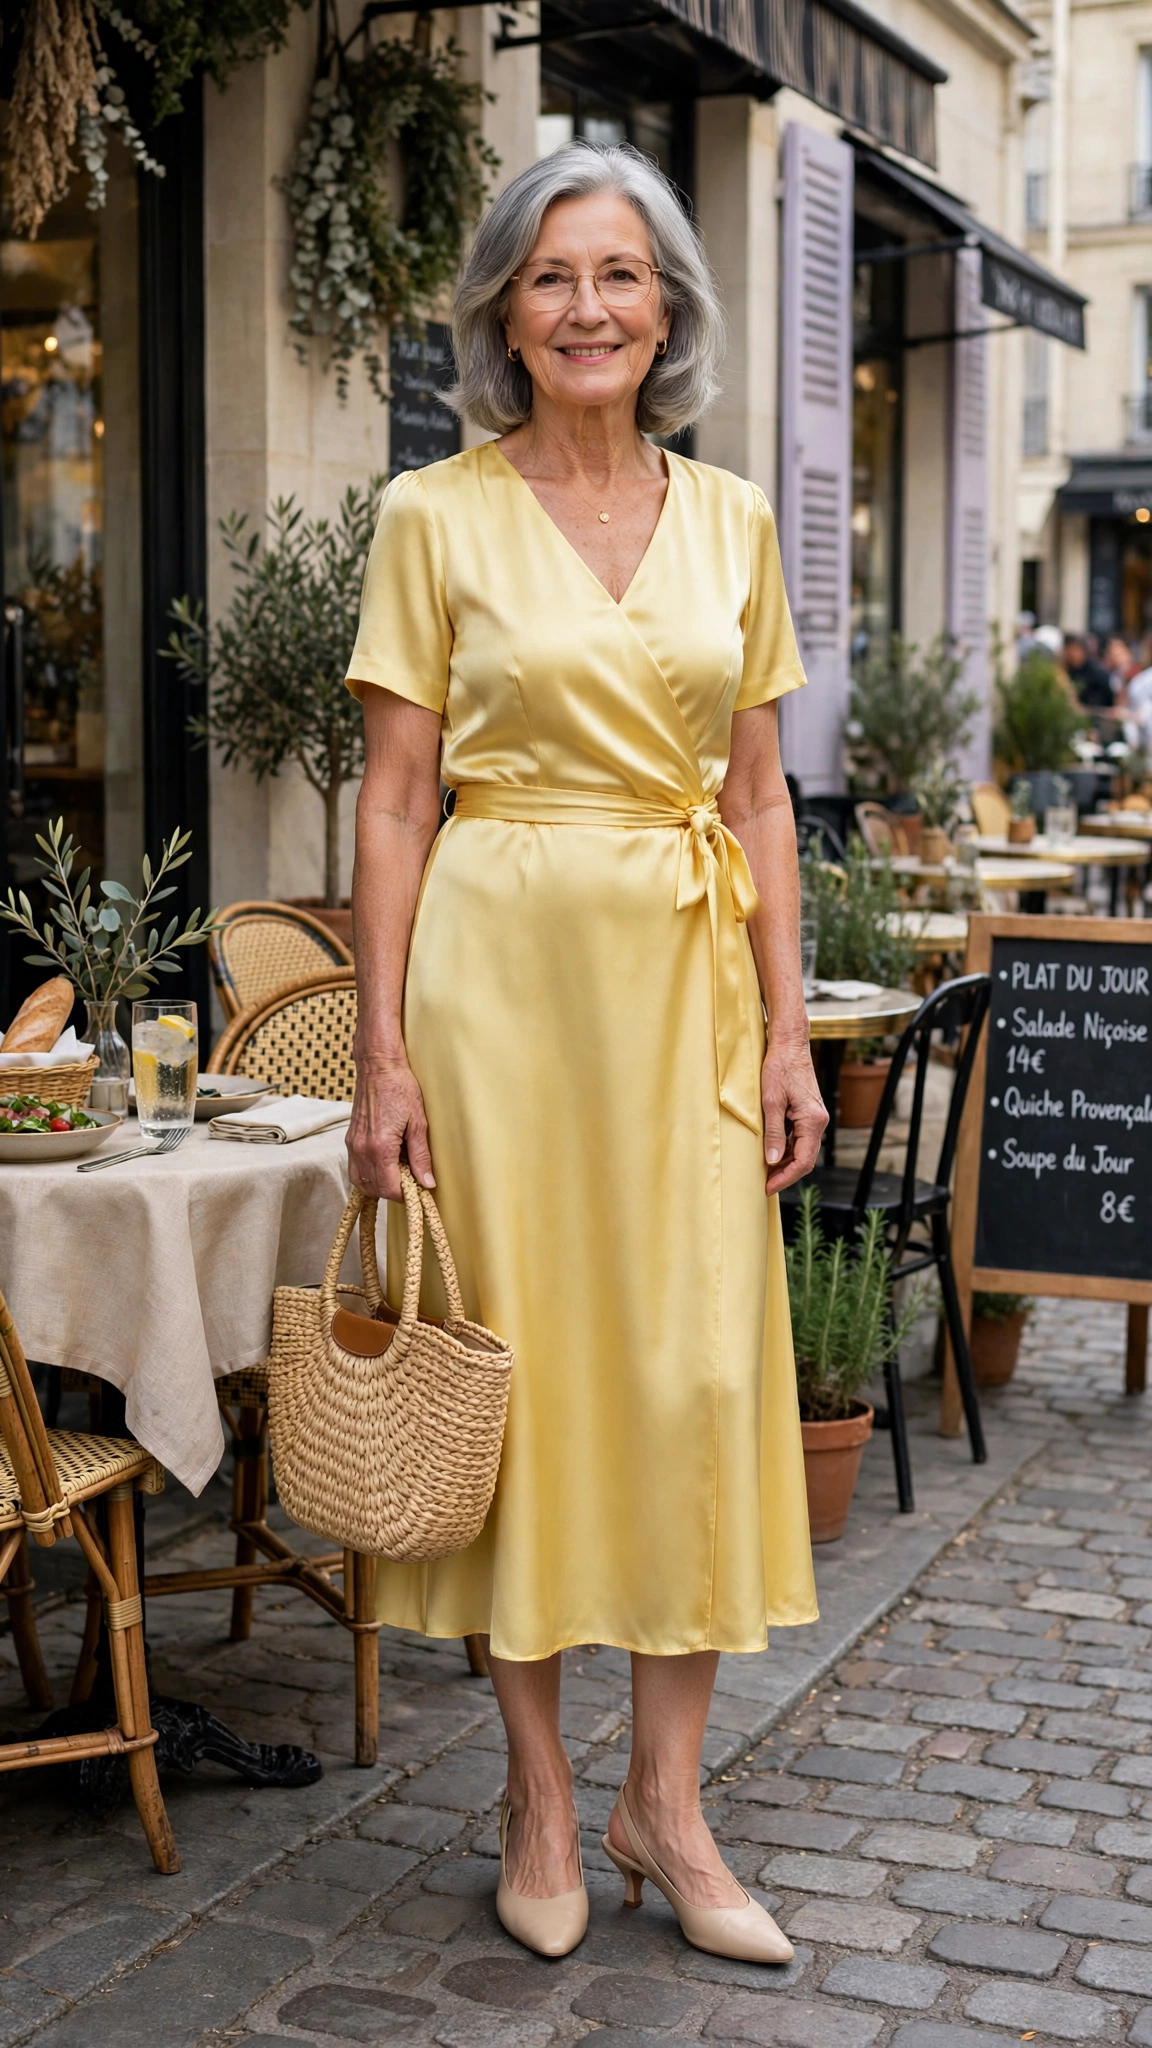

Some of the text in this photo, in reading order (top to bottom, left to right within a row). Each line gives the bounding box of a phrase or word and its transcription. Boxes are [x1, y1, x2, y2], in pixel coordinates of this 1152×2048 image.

[1011, 961, 1150, 996] PLAT DU JOUR
[1011, 1006, 1148, 1050] Salade Niçoise
[1006, 1044, 1046, 1074] 14€
[1003, 1086, 1152, 1130] Quiche Provençal
[1001, 1137, 1135, 1180] Soupe du Jour
[1100, 1190, 1136, 1224] 8€
